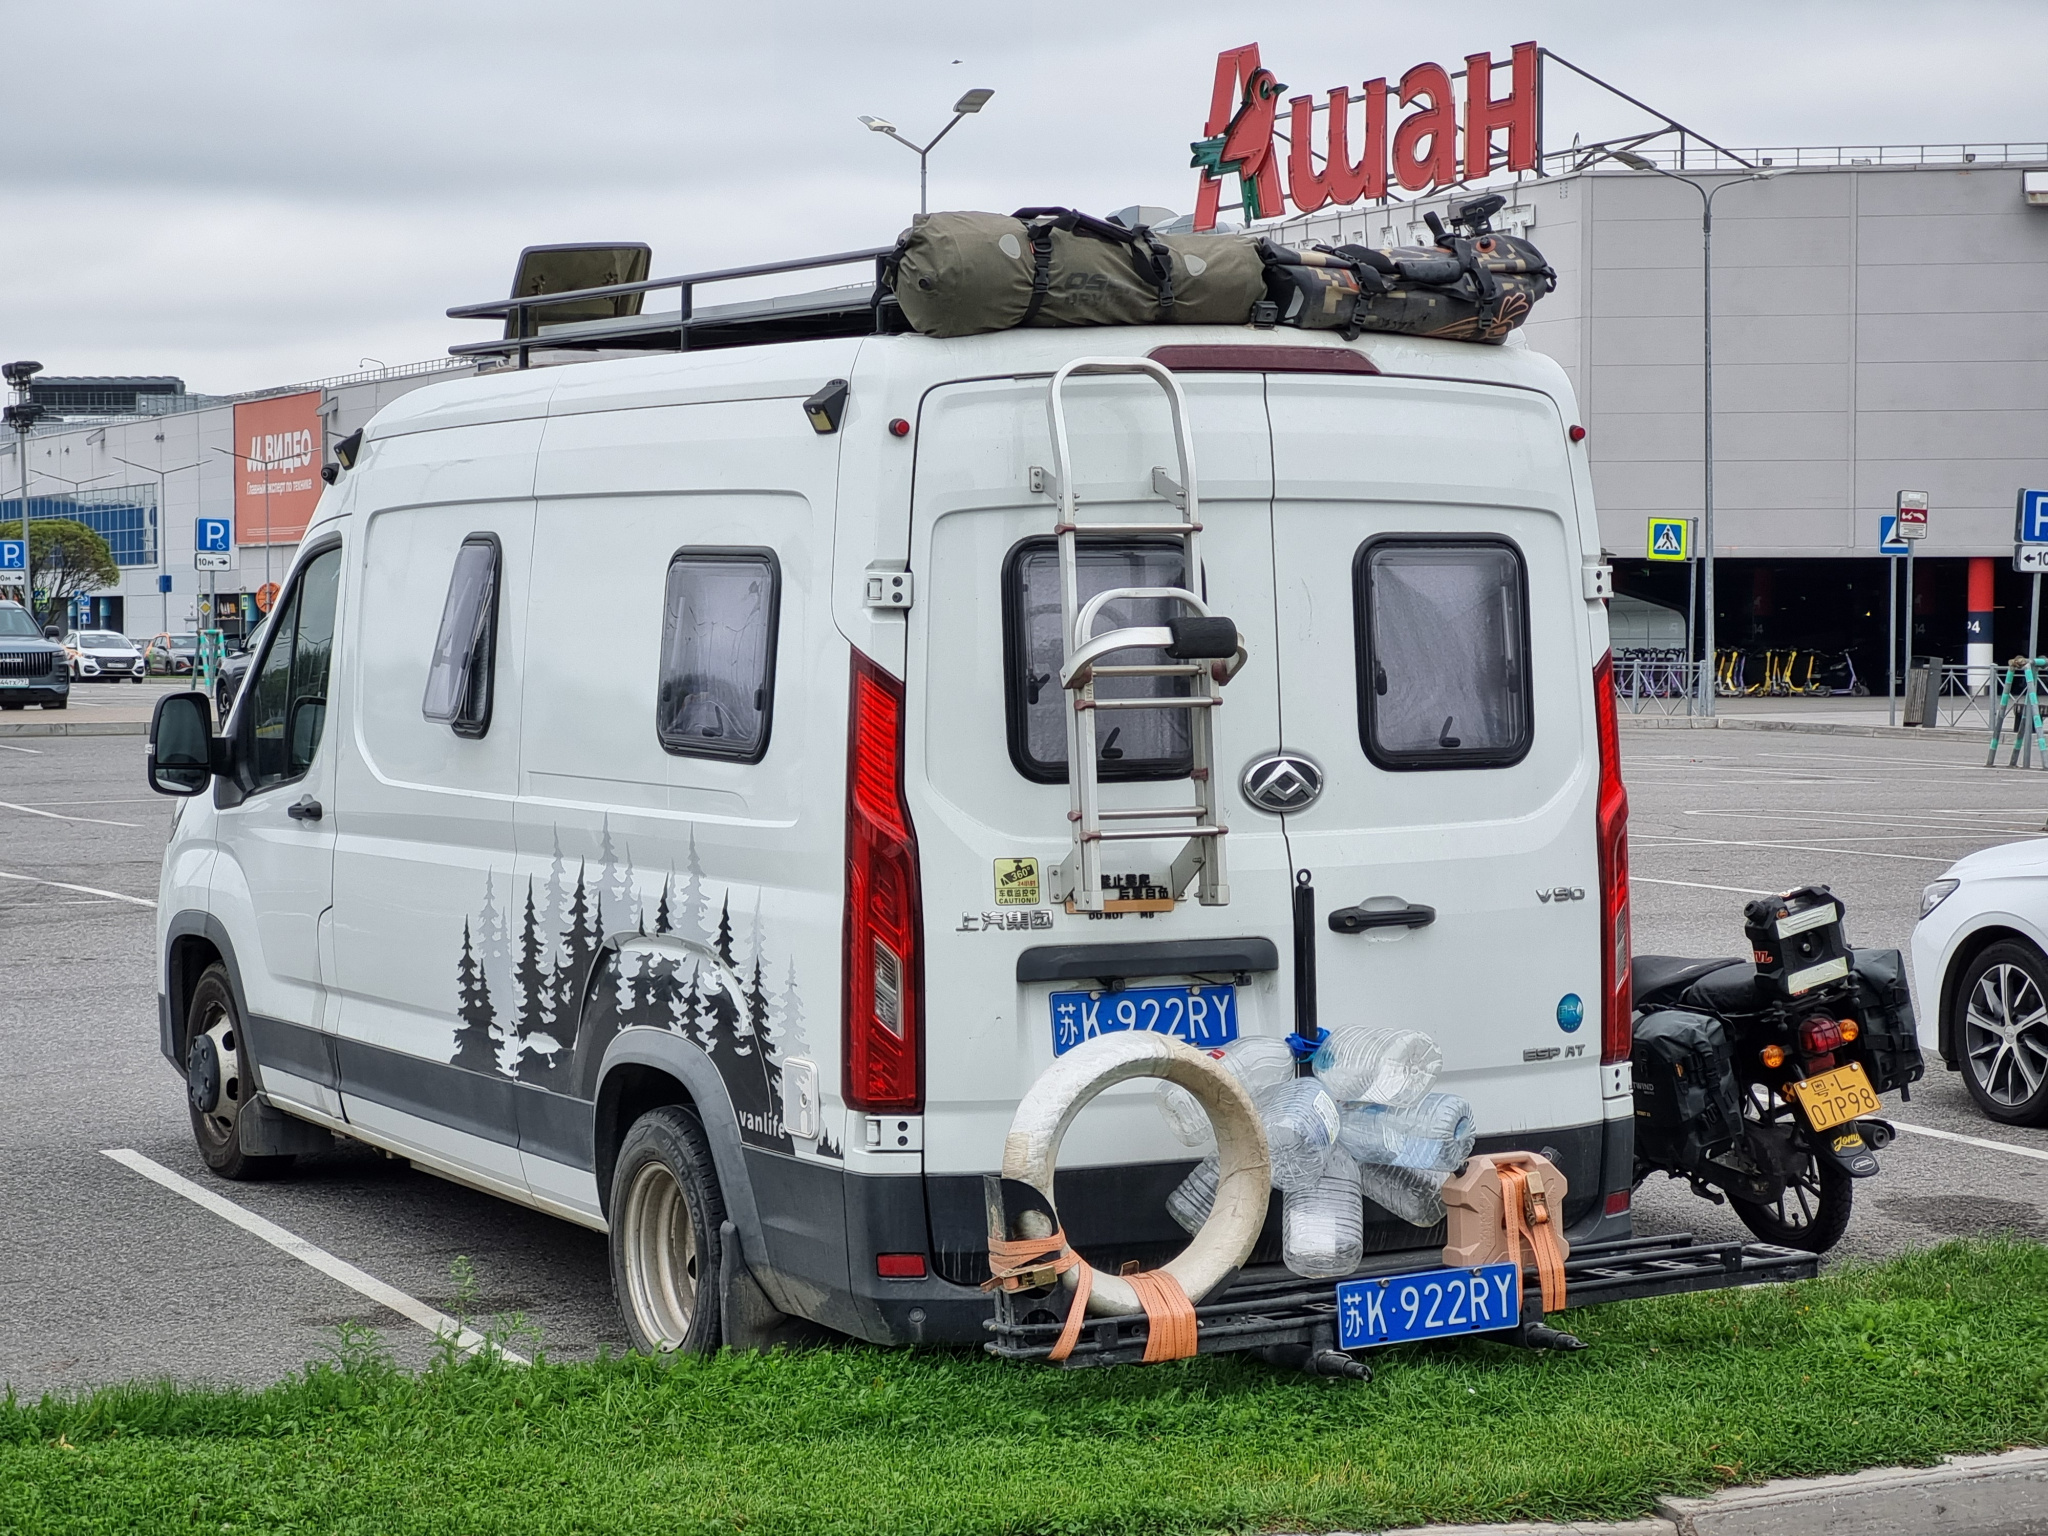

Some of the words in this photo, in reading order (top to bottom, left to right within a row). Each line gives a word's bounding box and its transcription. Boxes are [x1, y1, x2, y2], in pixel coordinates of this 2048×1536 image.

[1192, 40, 1538, 232] Ашан
[206, 521, 225, 548] P
[3, 543, 20, 567] P
[1535, 885, 1586, 904] V90
[955, 909, 1053, 931] 上汽集团
[1523, 1047, 1561, 1062] ESP
[1564, 1044, 1586, 1059] AT
[1811, 1087, 1875, 1126] 07P98
[738, 1110, 785, 1139] vanlife
[1343, 1273, 1512, 1338] 苏K·922RY
